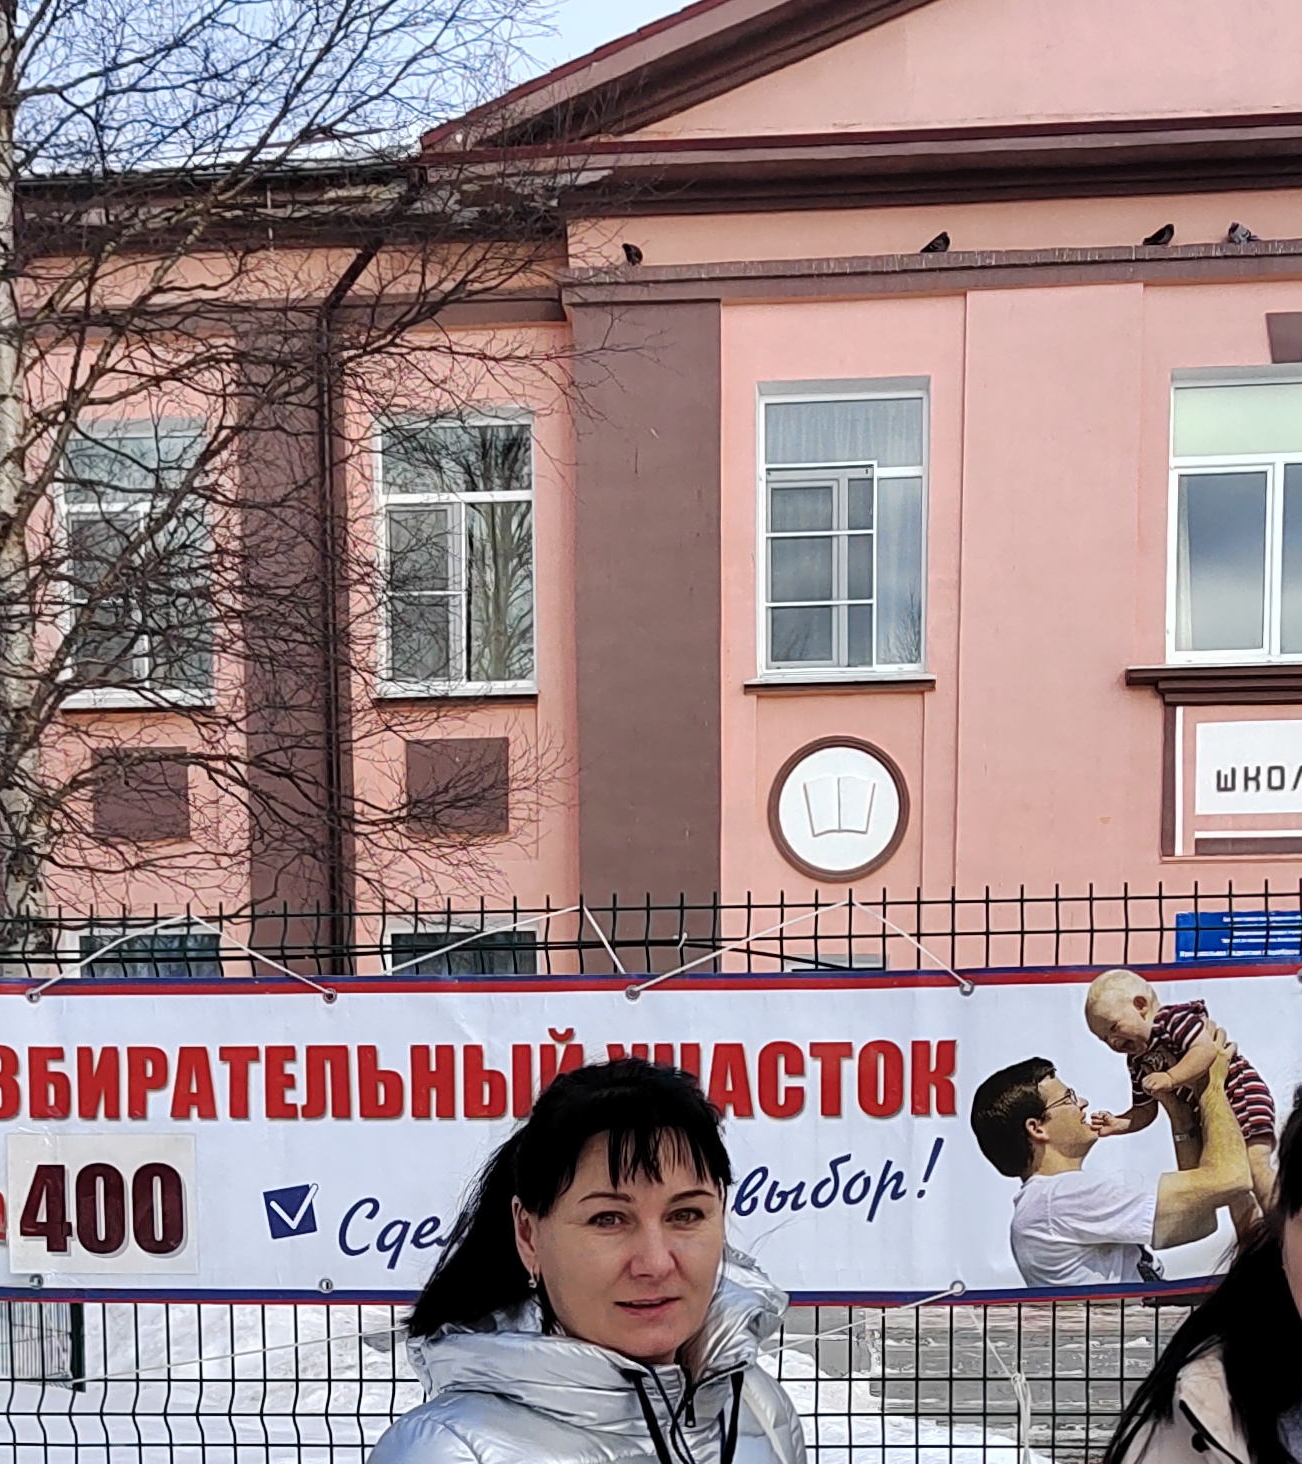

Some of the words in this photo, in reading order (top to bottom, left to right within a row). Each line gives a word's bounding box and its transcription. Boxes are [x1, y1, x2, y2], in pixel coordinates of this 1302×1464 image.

[606, 1040, 958, 1119] АСТОК
[20, 1162, 185, 1255] 400
[338, 1197, 450, 1270] Сде
[731, 1137, 945, 1222] выбор!
